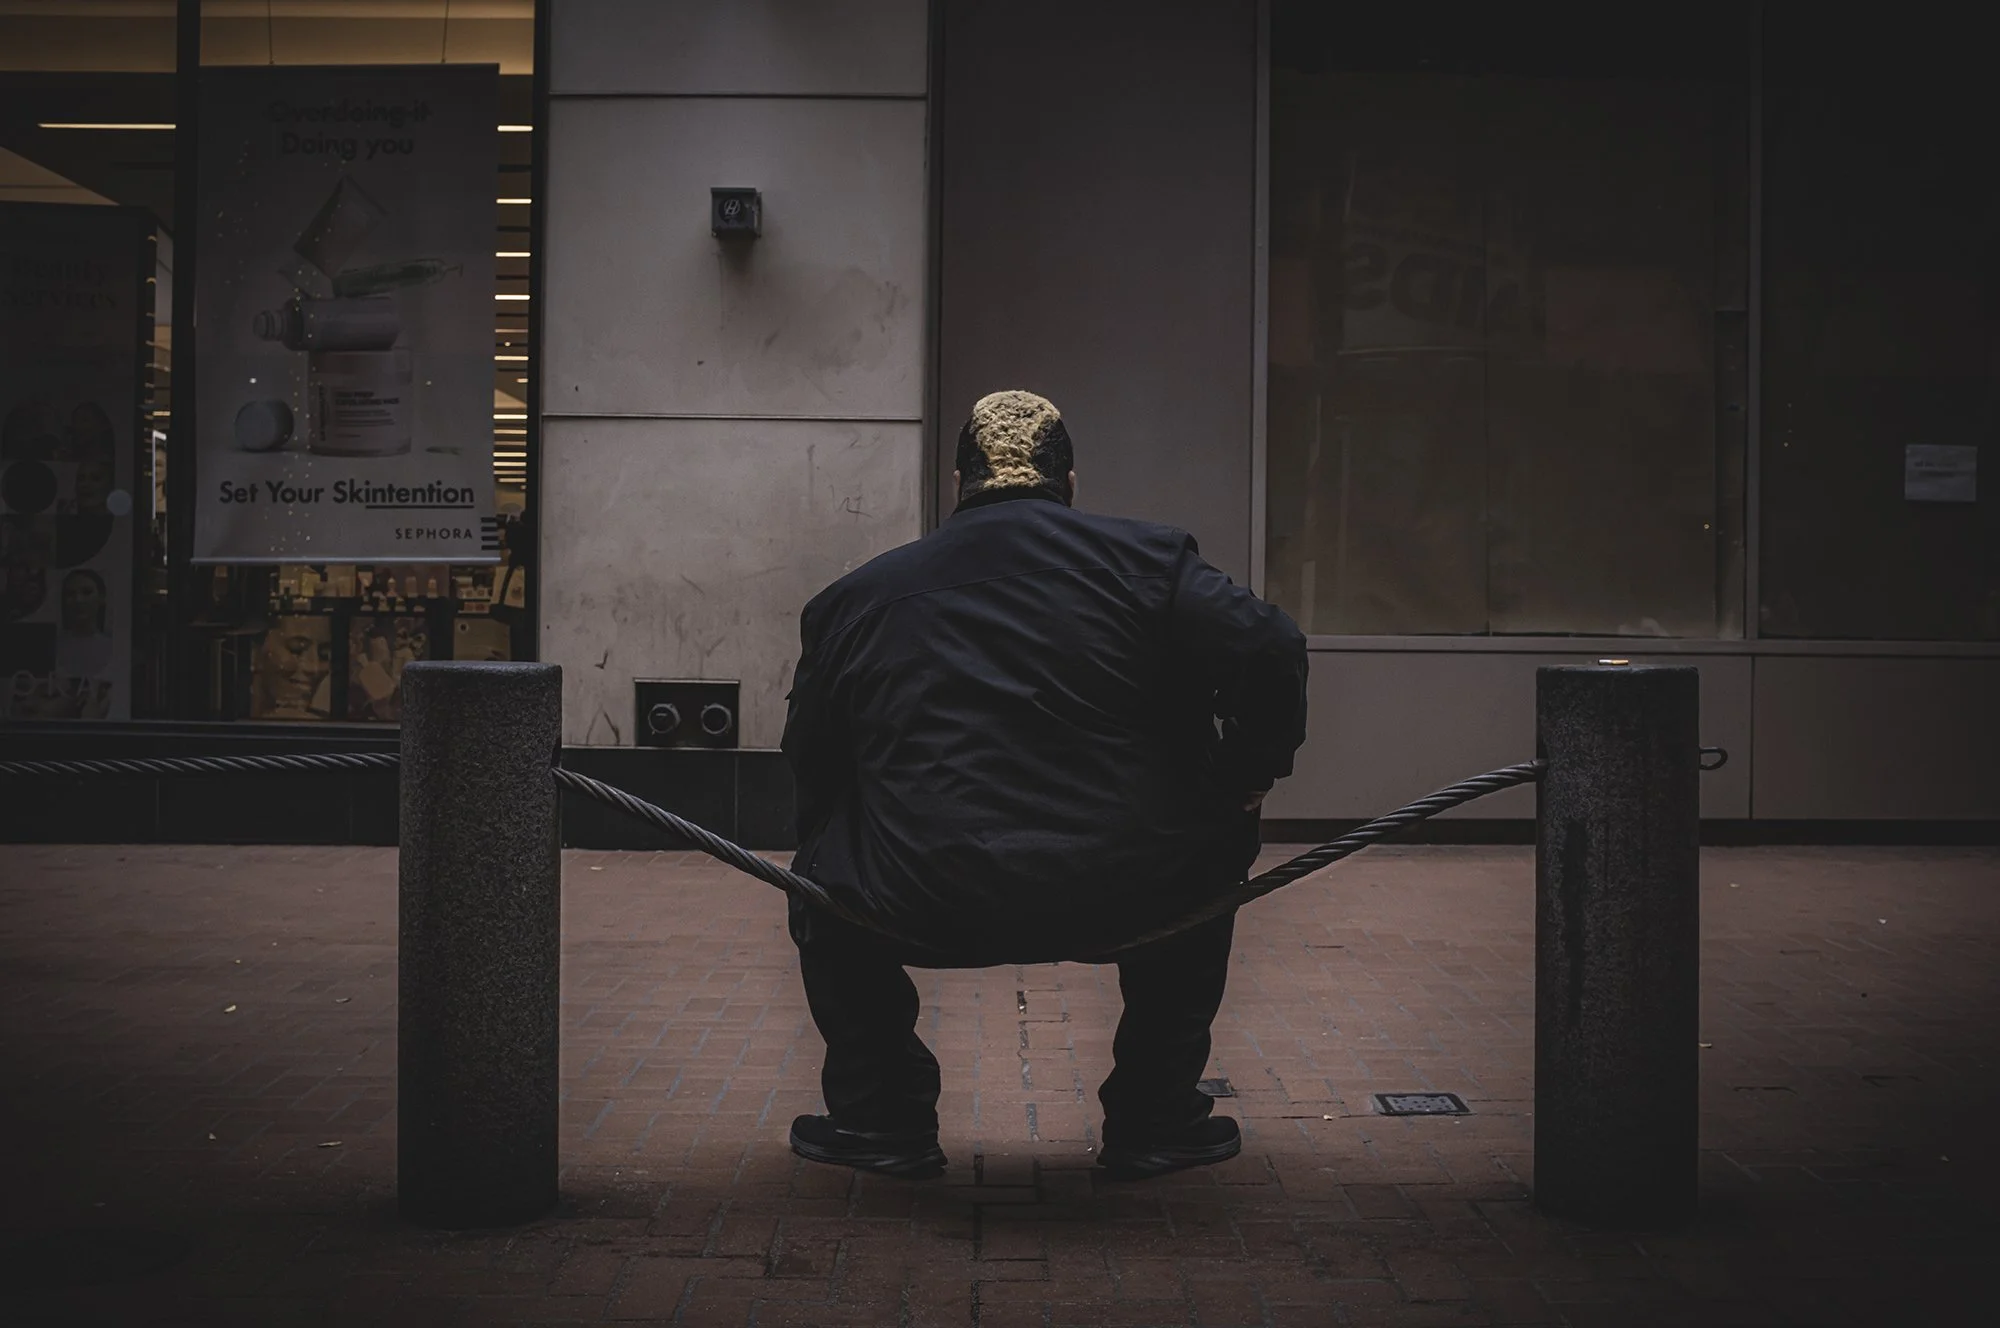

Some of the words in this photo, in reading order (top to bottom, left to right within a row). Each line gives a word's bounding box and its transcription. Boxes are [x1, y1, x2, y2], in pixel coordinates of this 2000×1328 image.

[266, 97, 406, 129] Overdoing
[281, 130, 358, 161] Doing
[365, 138, 415, 161] you
[219, 480, 259, 505] Set
[265, 480, 325, 505] Your
[332, 478, 475, 505] Skintention
[395, 528, 473, 540] SEPHORA
